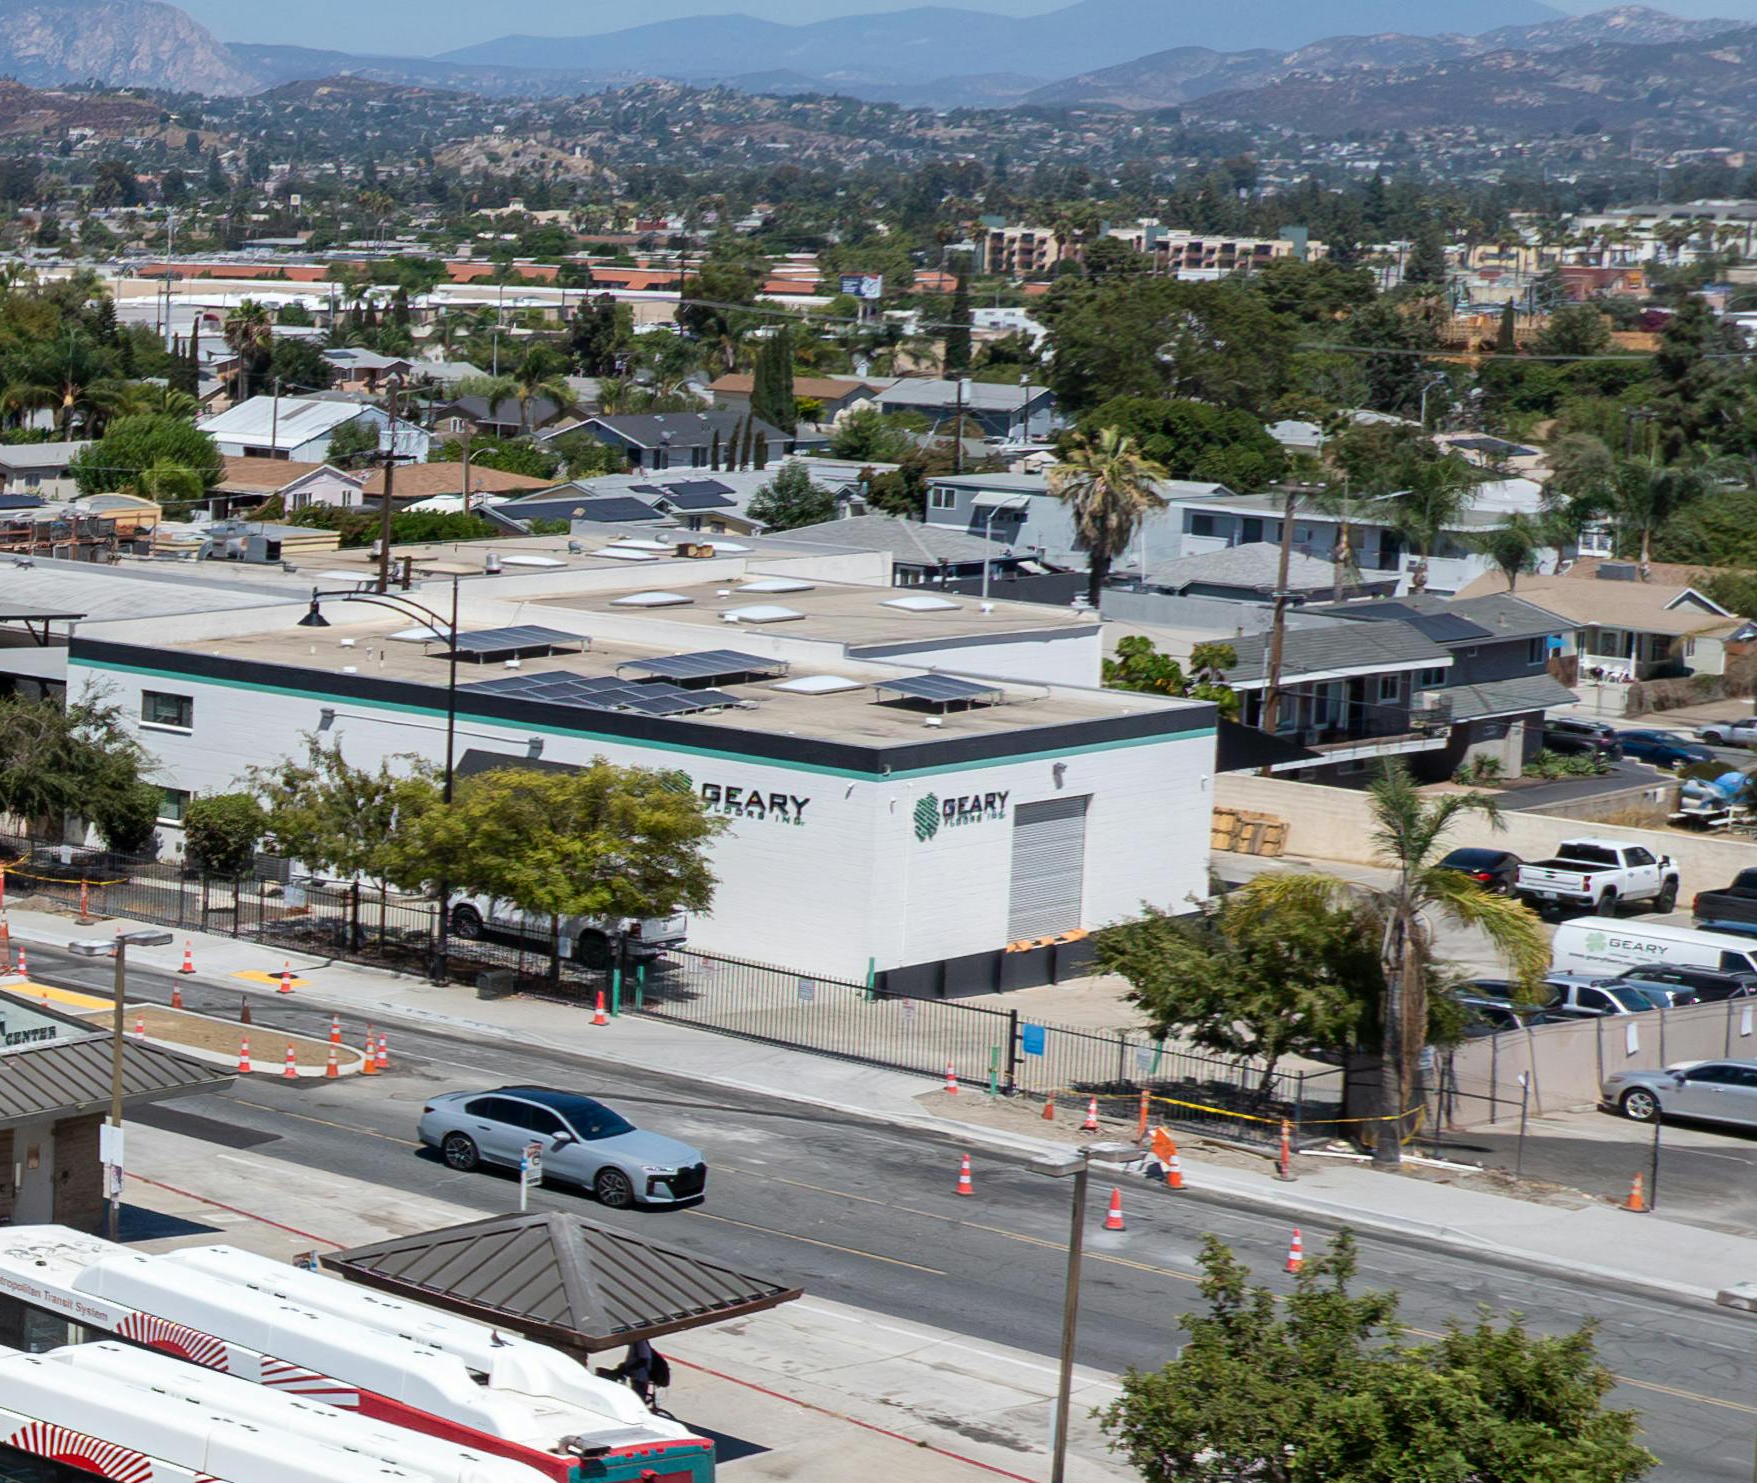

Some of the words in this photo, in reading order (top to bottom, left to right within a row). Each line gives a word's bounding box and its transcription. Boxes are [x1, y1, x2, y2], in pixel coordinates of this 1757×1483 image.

[702, 783, 811, 816] GEARY
[943, 790, 1010, 817] GEARY
[1609, 937, 1669, 955] GEARY
[5, 1026, 56, 1046] CENTER
[44, 1289, 73, 1310] Transit
[75, 1302, 108, 1322] System
